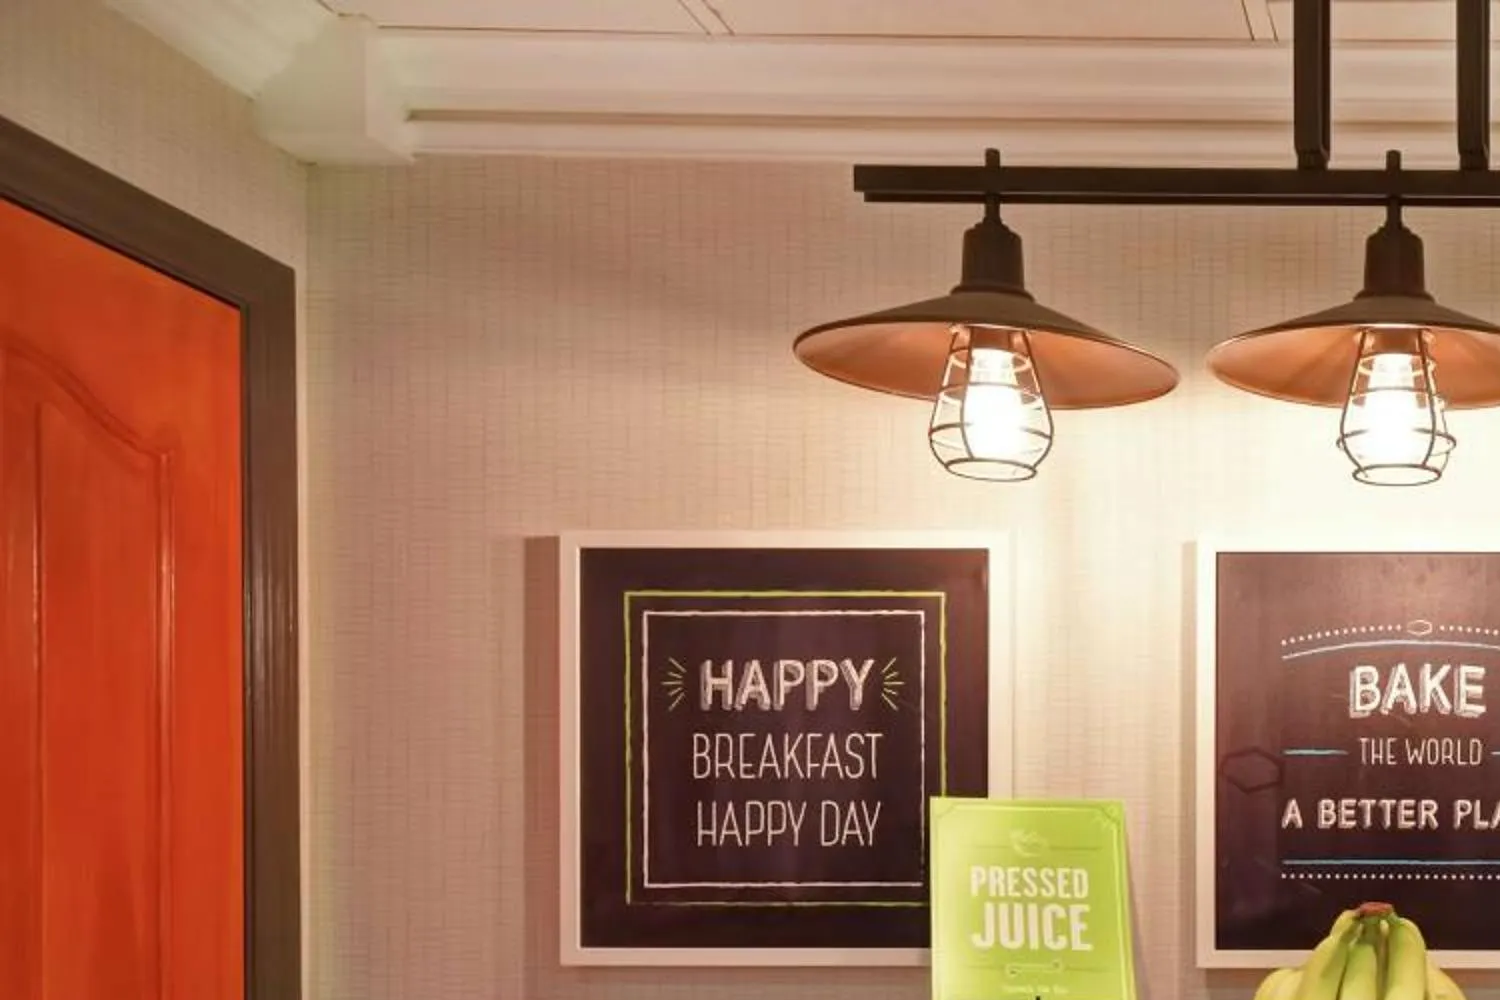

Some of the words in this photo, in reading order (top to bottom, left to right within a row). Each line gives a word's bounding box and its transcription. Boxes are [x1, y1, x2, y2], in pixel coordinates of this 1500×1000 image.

[700, 659, 875, 711] HAPPY
[1349, 663, 1487, 718] BAKE
[692, 733, 883, 779] BREAKFAST
[1360, 738, 1397, 766] THE
[1405, 738, 1482, 766] WORLD
[697, 800, 807, 847] HAPPY
[820, 800, 881, 847] DAY
[1281, 798, 1303, 829] A
[1317, 798, 1439, 829] BETTER
[970, 865, 1089, 898] PRESSED
[971, 902, 1093, 951] JUICE
